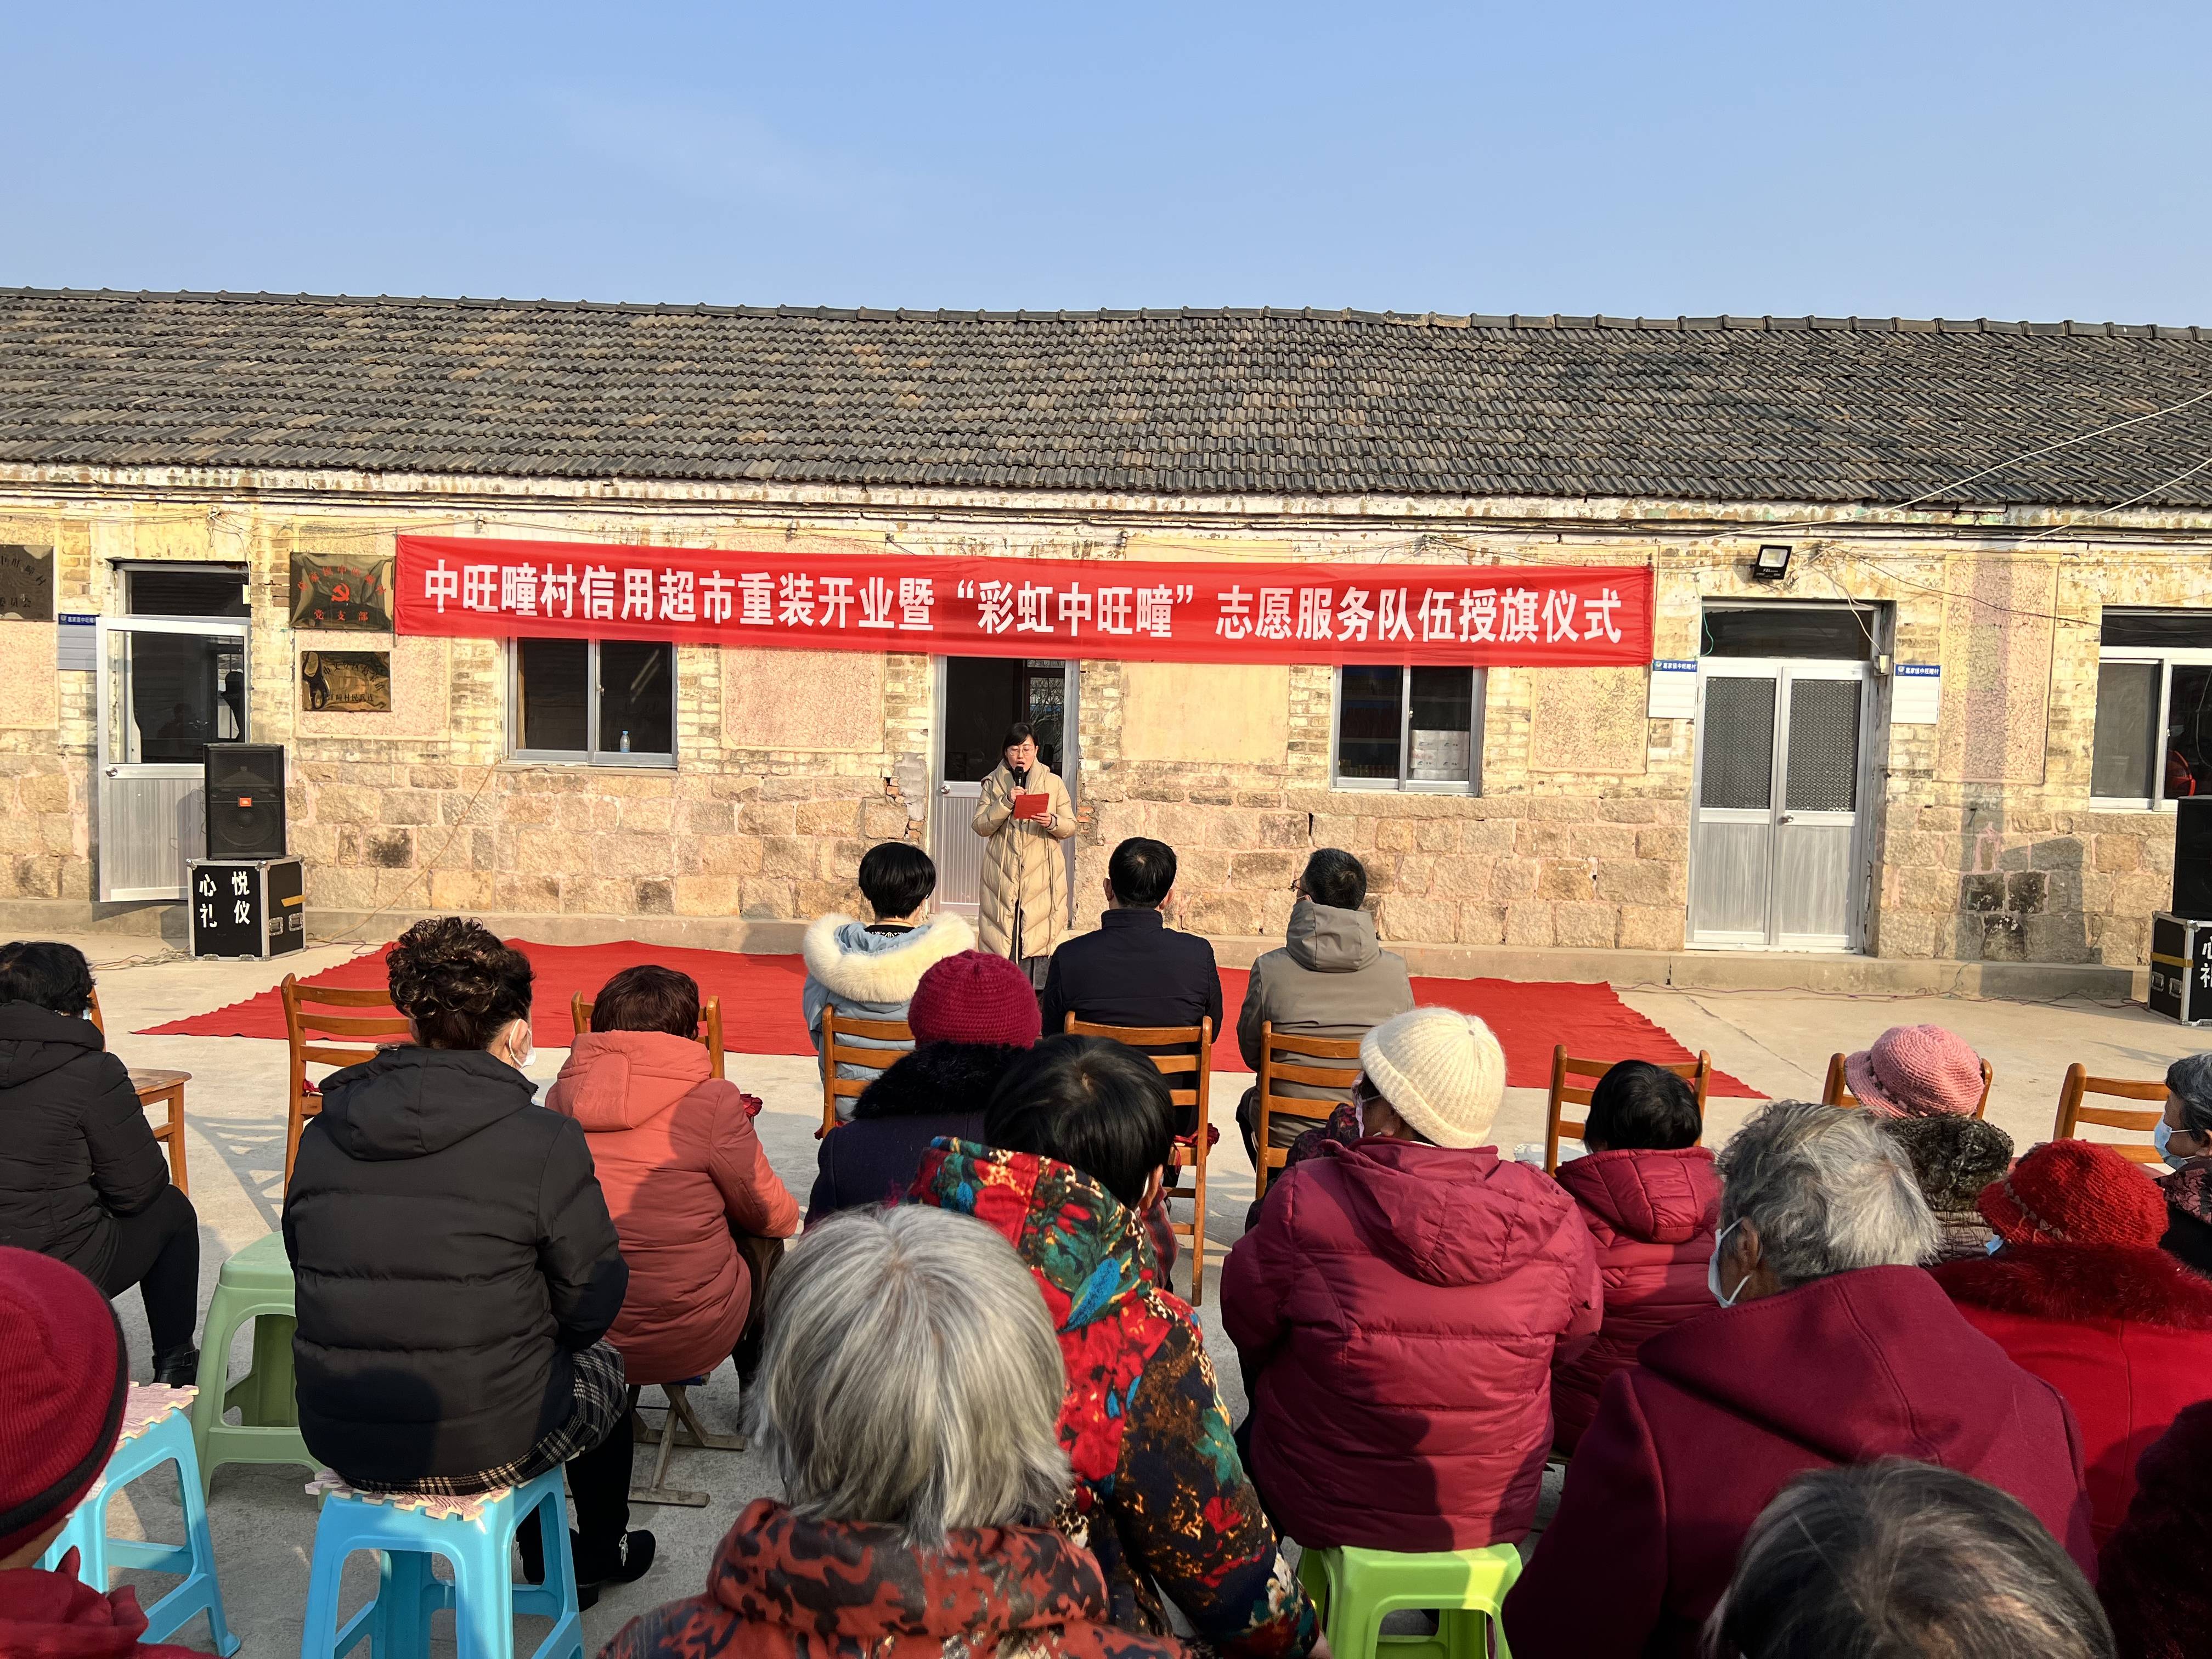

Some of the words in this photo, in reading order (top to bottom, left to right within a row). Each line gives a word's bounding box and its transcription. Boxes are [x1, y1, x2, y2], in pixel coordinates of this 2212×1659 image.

[314, 609, 369, 622] 党支部
[199, 871, 250, 897] 心悦
[199, 900, 251, 928] 礼仪
